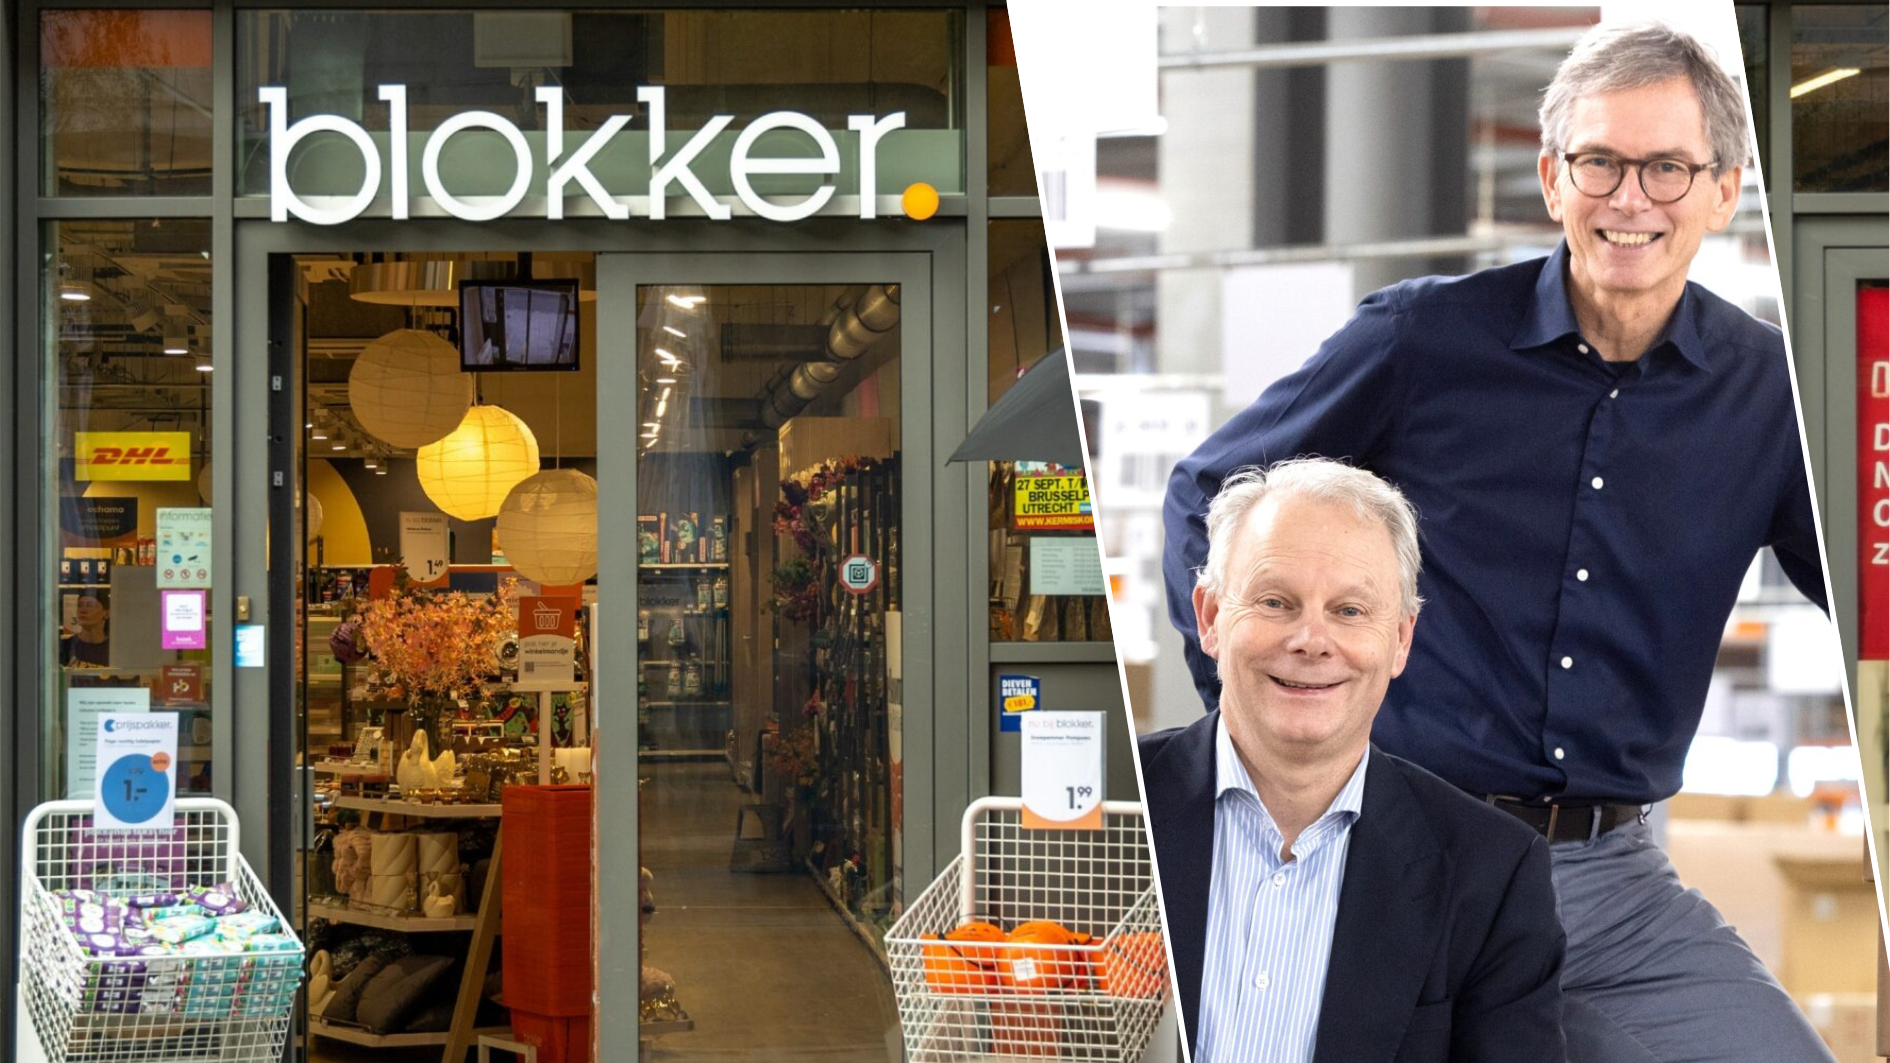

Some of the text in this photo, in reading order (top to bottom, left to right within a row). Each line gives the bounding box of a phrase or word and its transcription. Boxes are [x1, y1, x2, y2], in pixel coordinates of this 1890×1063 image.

[92, 447, 174, 465] DHL
[1017, 479, 1030, 490] 27
[1034, 478, 1064, 490] SEPT.
[1028, 490, 1089, 502] BRUSSELP
[1022, 502, 1074, 514] UTRECHT
[525, 648, 569, 656] winkelmandje
[1002, 680, 1031, 688] DIEVEN
[1002, 687, 1037, 697] BETALEN
[1066, 786, 1093, 810] 1.99
